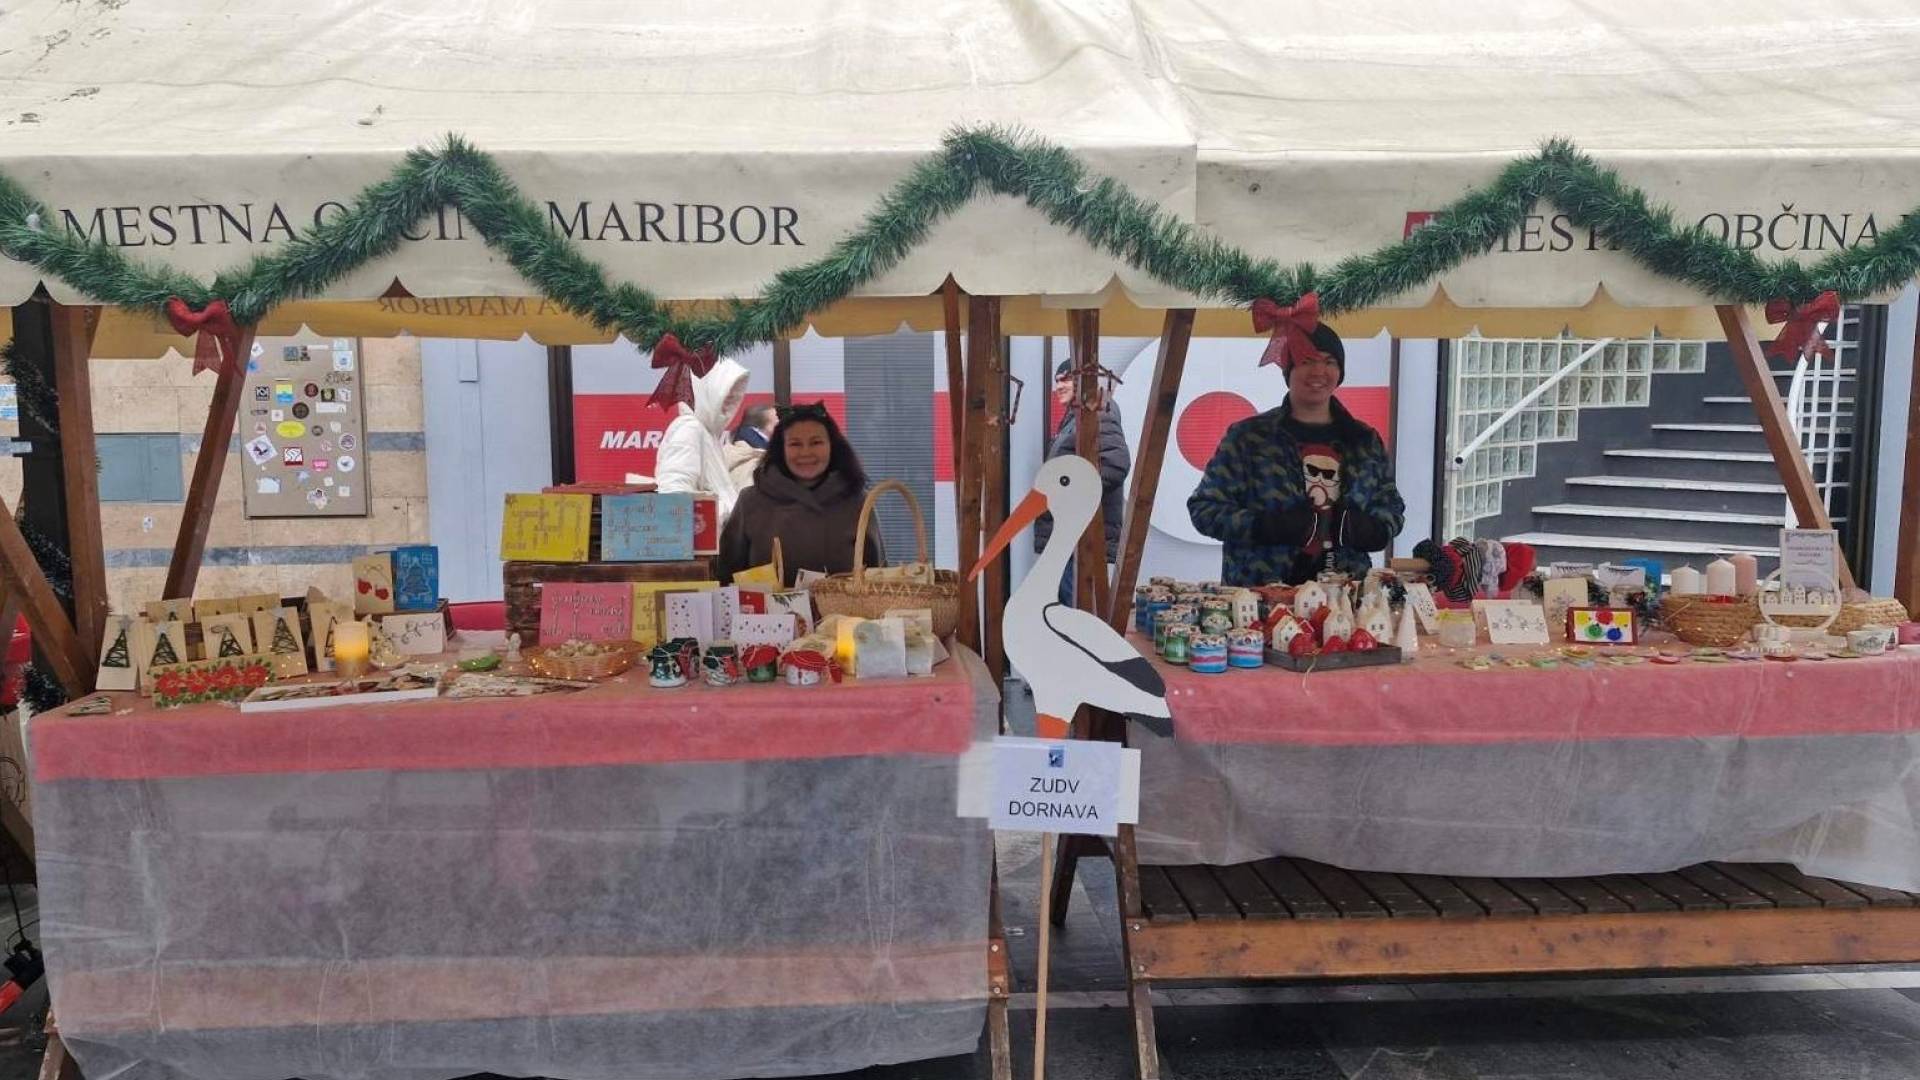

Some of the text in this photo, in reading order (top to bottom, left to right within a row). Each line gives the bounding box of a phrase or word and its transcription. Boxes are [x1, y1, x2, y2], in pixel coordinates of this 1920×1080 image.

[59, 202, 299, 247] MESTNA
[547, 201, 805, 246] MARIBOR
[1698, 202, 1882, 251] OBČINA
[600, 430, 665, 449] MAR
[1029, 777, 1081, 794] ZUDV
[1008, 801, 1099, 820] DORNAVA
